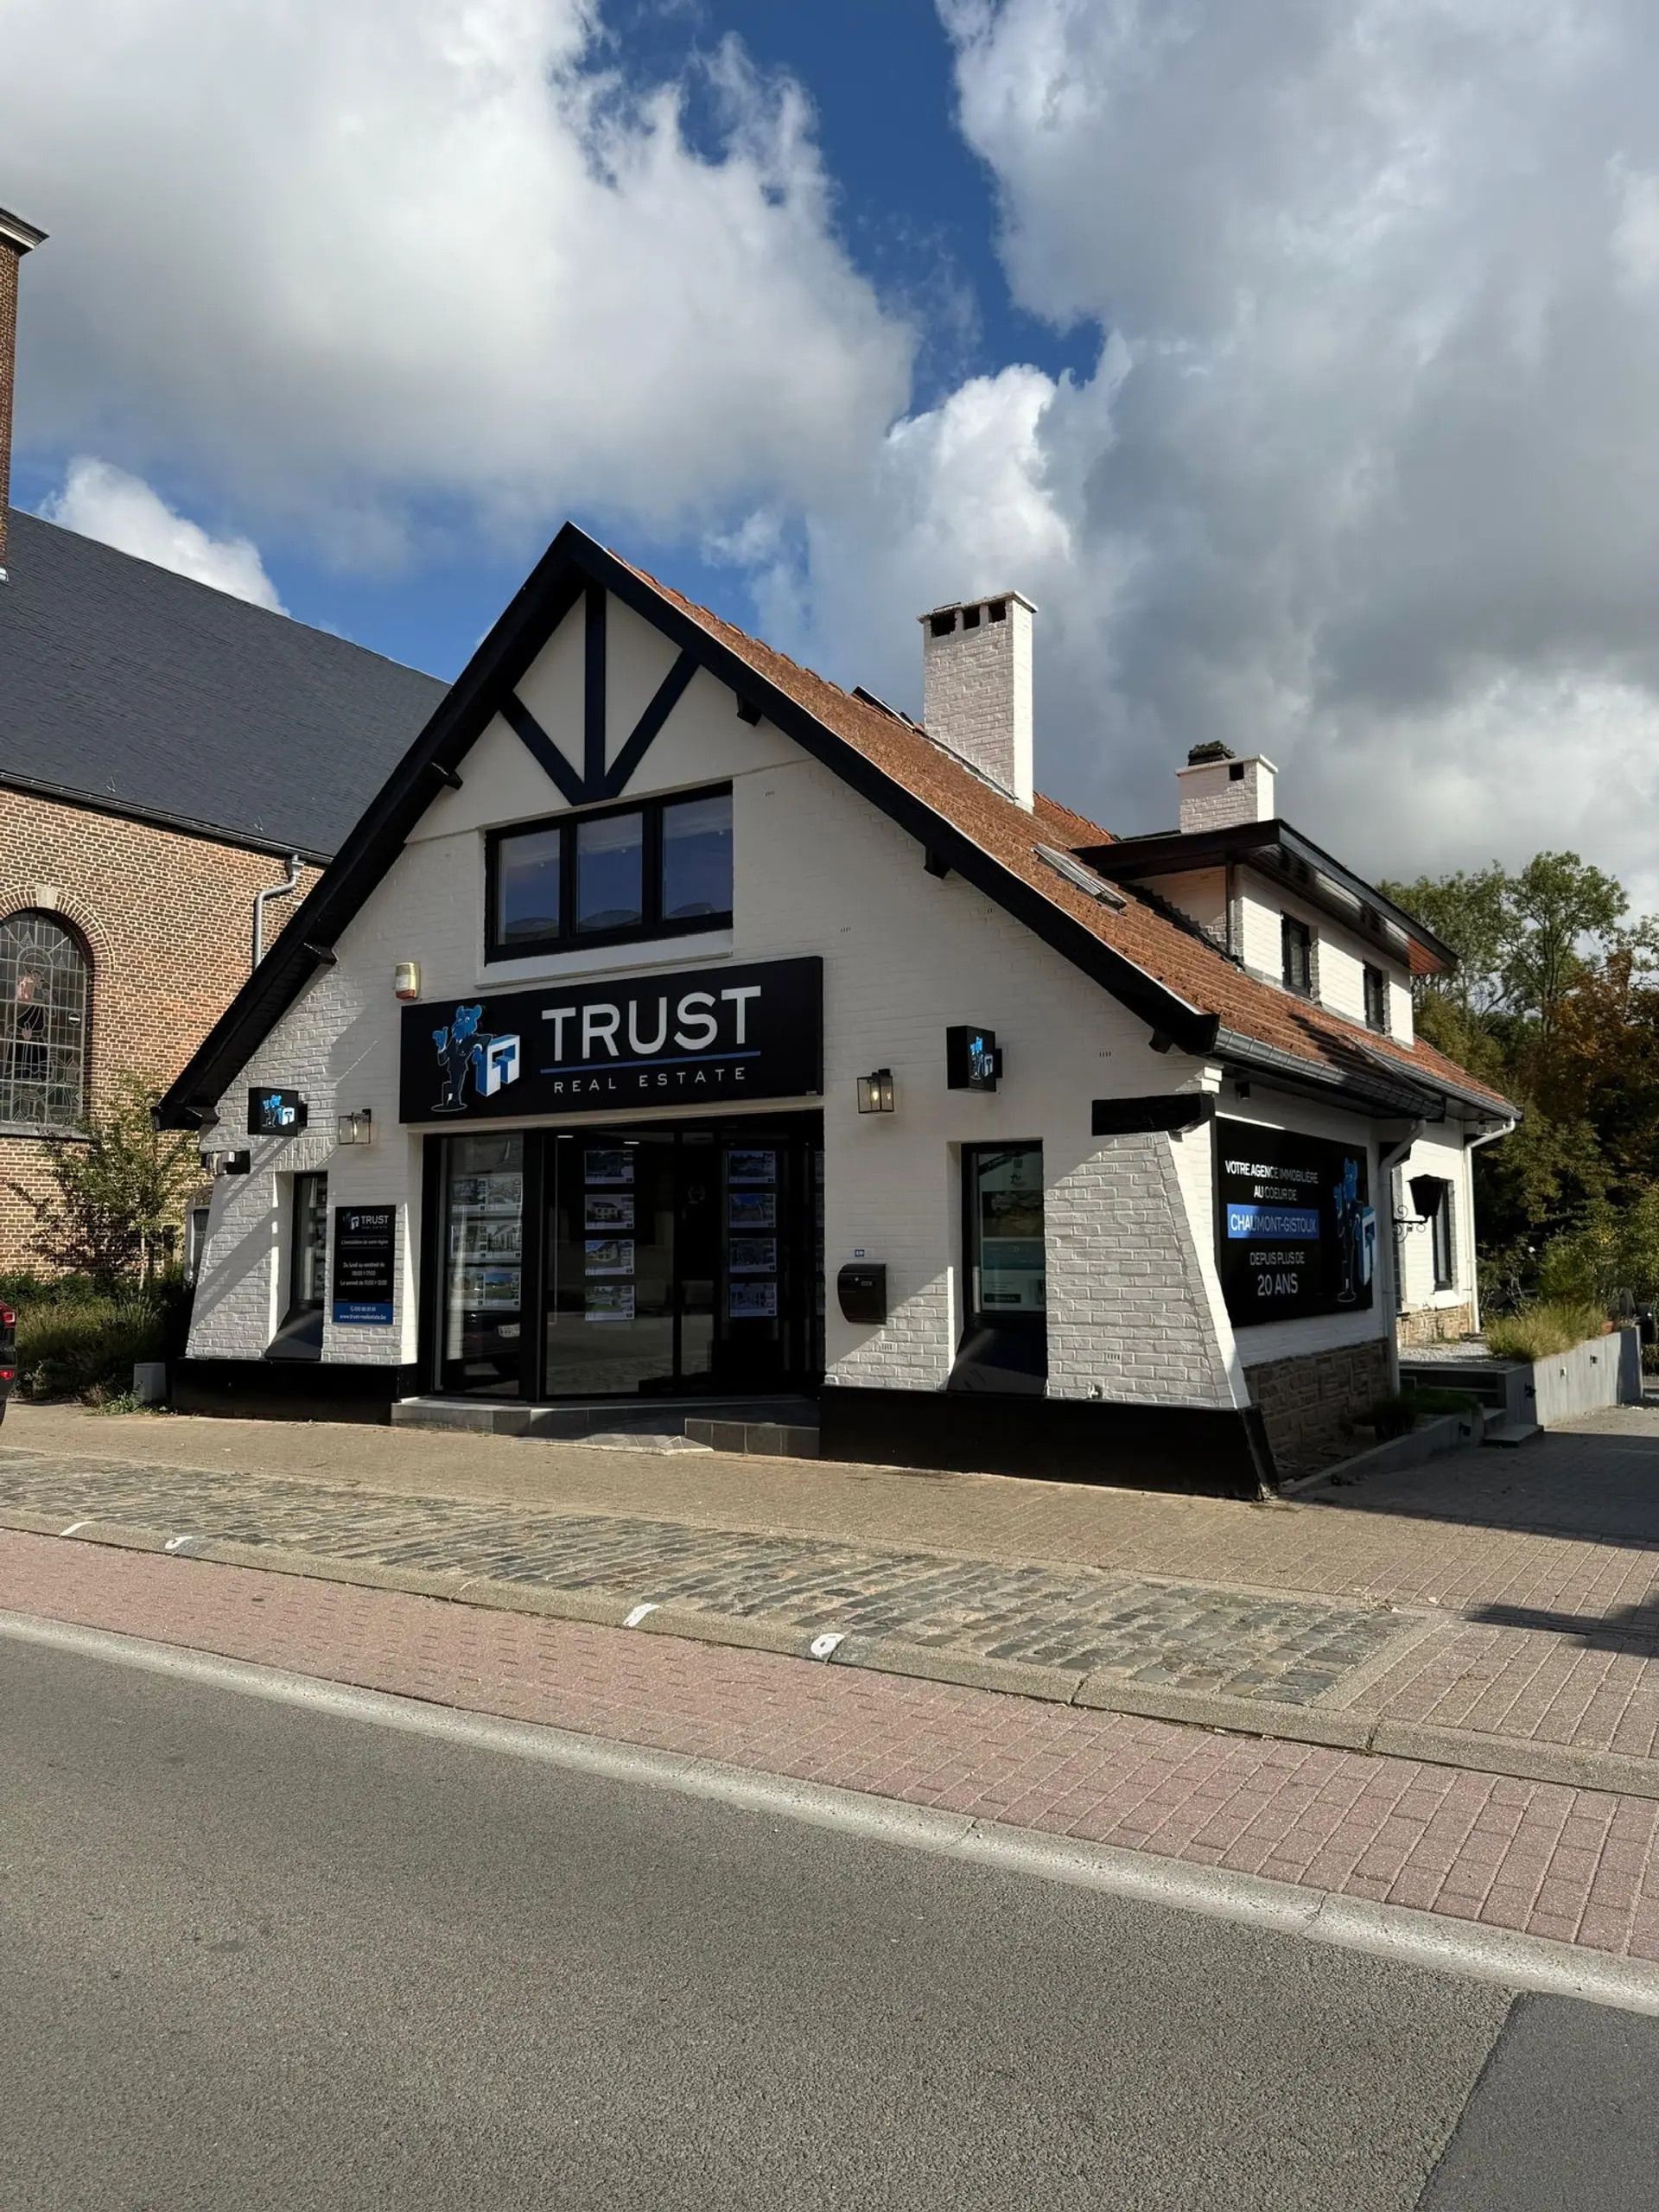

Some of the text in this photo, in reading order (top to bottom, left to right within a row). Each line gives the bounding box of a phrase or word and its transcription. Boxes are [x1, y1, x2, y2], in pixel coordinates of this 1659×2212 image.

[542, 985, 761, 1062] TRUST
[554, 1067, 746, 1093] REAL ESTATE
[1225, 1160, 1250, 1176] VOTRE
[1251, 1164, 1279, 1179] AGENCE
[1254, 1185, 1298, 1201] AU COEUR DE
[360, 1215, 390, 1224] TRUST
[1230, 1213, 1317, 1233] CHAUMONT-GISTOUX
[1249, 1251, 1306, 1266] DEPUIS PLUS DE
[1257, 1272, 1299, 1296] 20 ANS
